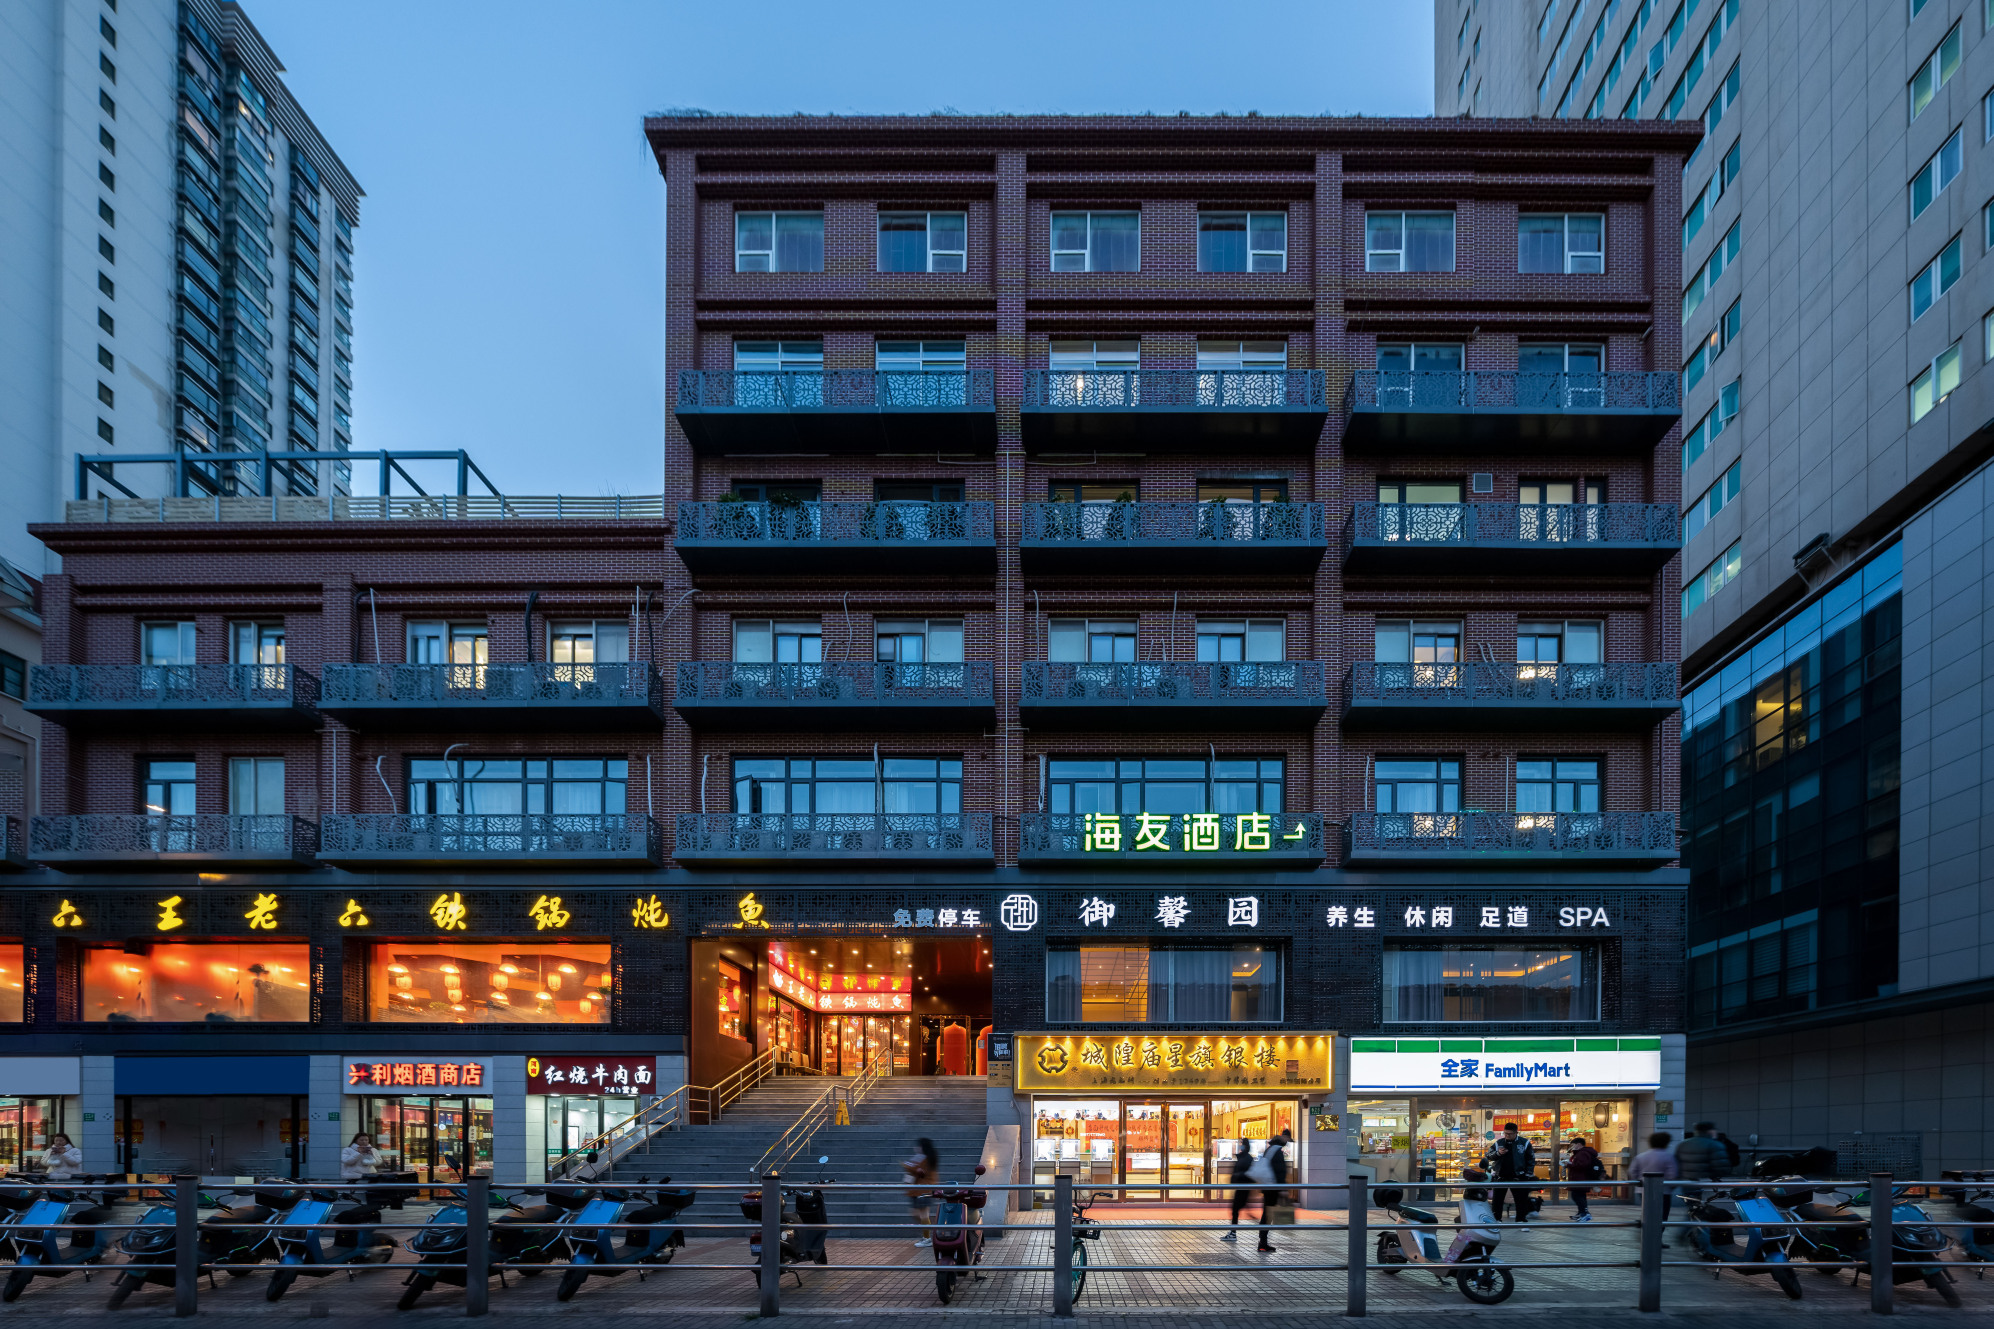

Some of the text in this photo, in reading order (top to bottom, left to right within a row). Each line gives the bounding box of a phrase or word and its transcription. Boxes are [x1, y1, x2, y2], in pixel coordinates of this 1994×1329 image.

[1085, 812, 1271, 851] 海友酒店
[893, 908, 981, 928] 免费停车
[1078, 895, 1259, 928] 御馨园
[1326, 905, 1610, 928] 养生 休闲 足道 SPA
[1081, 1042, 1281, 1070] 城隍庙星旗银楼
[348, 1062, 482, 1086] 兴利烟酒商店
[544, 1063, 652, 1086] 红烧牛肉面
[1440, 1059, 1571, 1082] 全家 FamilyMart
[604, 1085, 639, 1094] 24h营业
